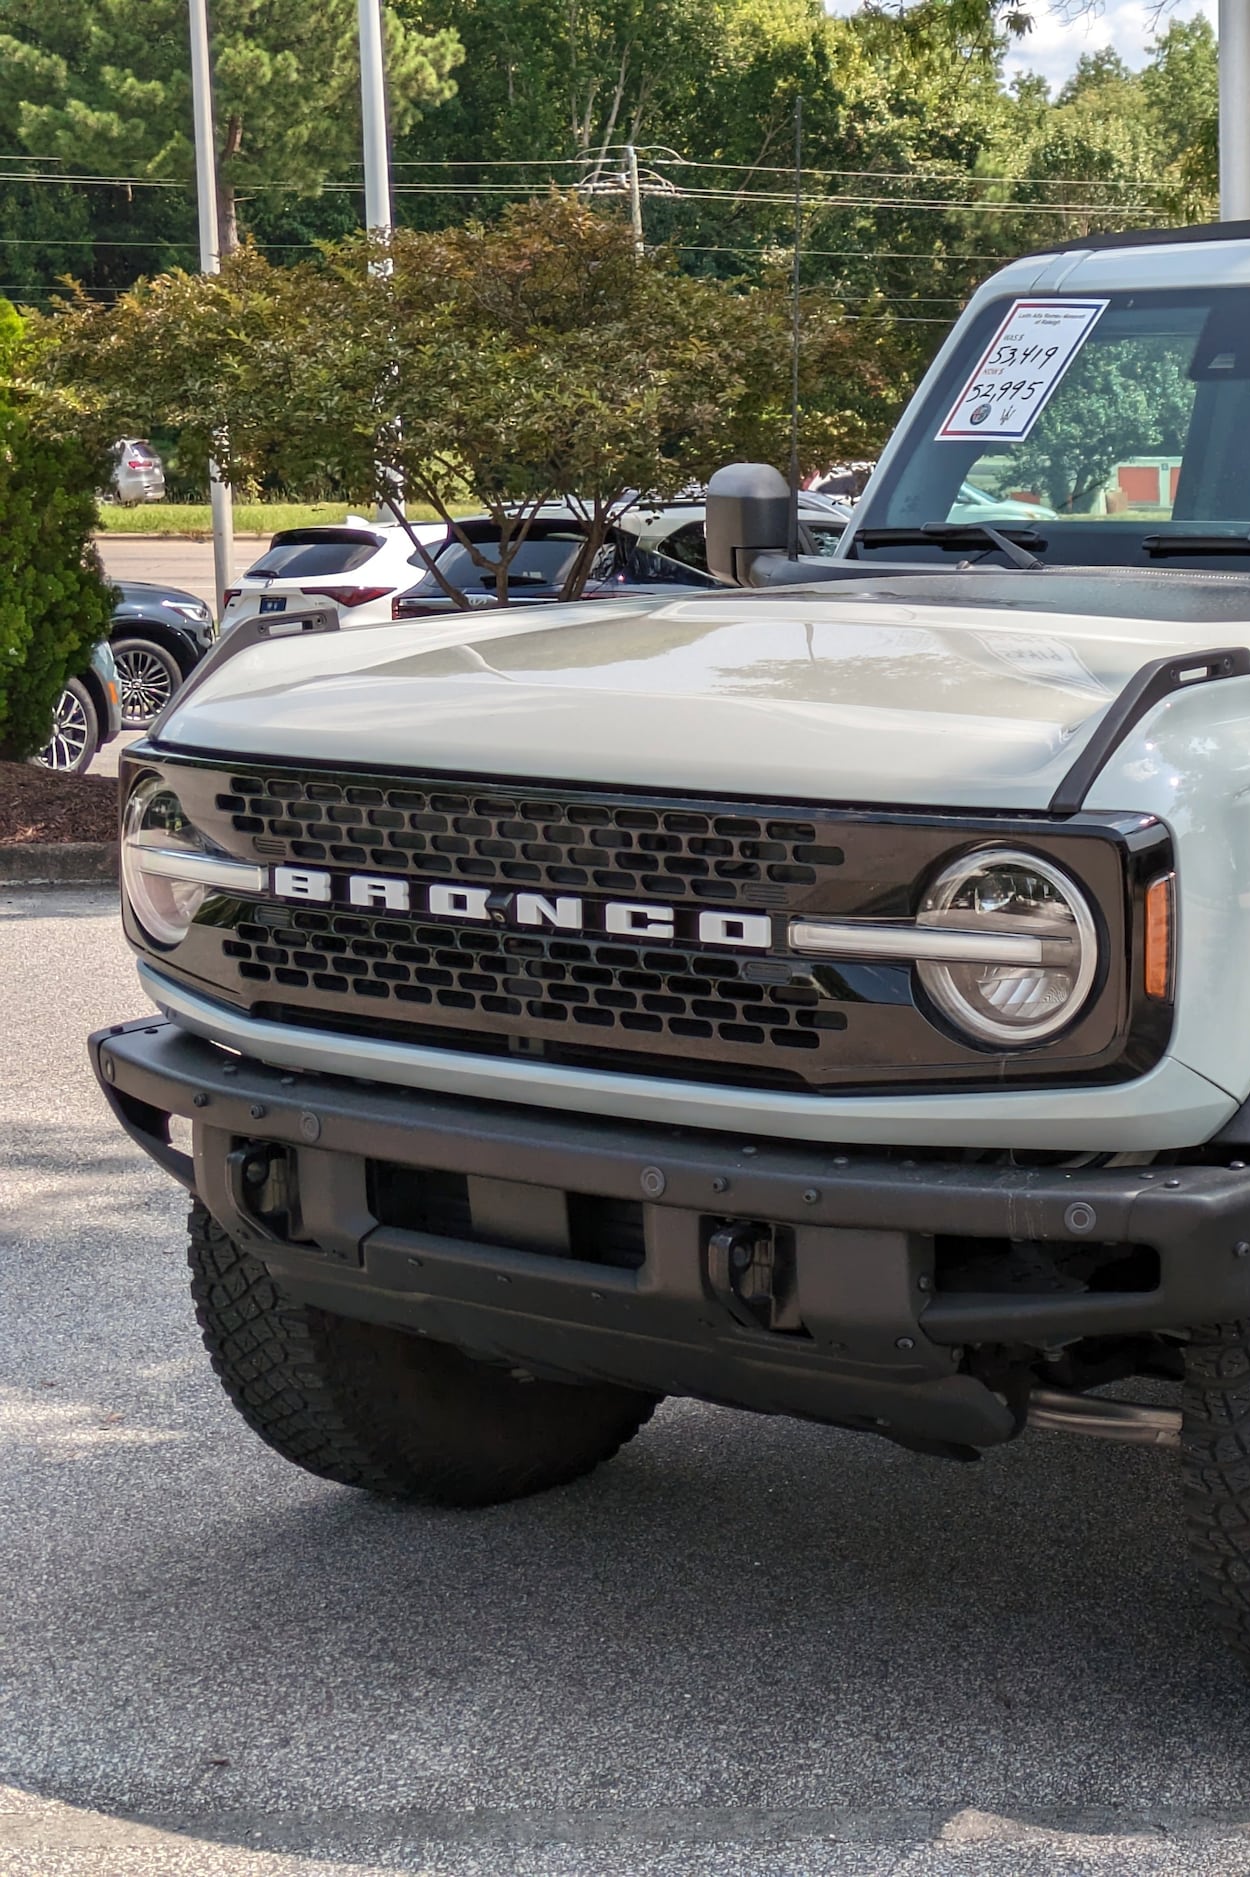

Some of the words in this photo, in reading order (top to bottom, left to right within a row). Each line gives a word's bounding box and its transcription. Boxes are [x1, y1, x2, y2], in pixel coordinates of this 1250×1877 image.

[988, 344, 1059, 370] 53,419
[965, 380, 1044, 403] 52,995
[274, 866, 772, 949] BRONCO
